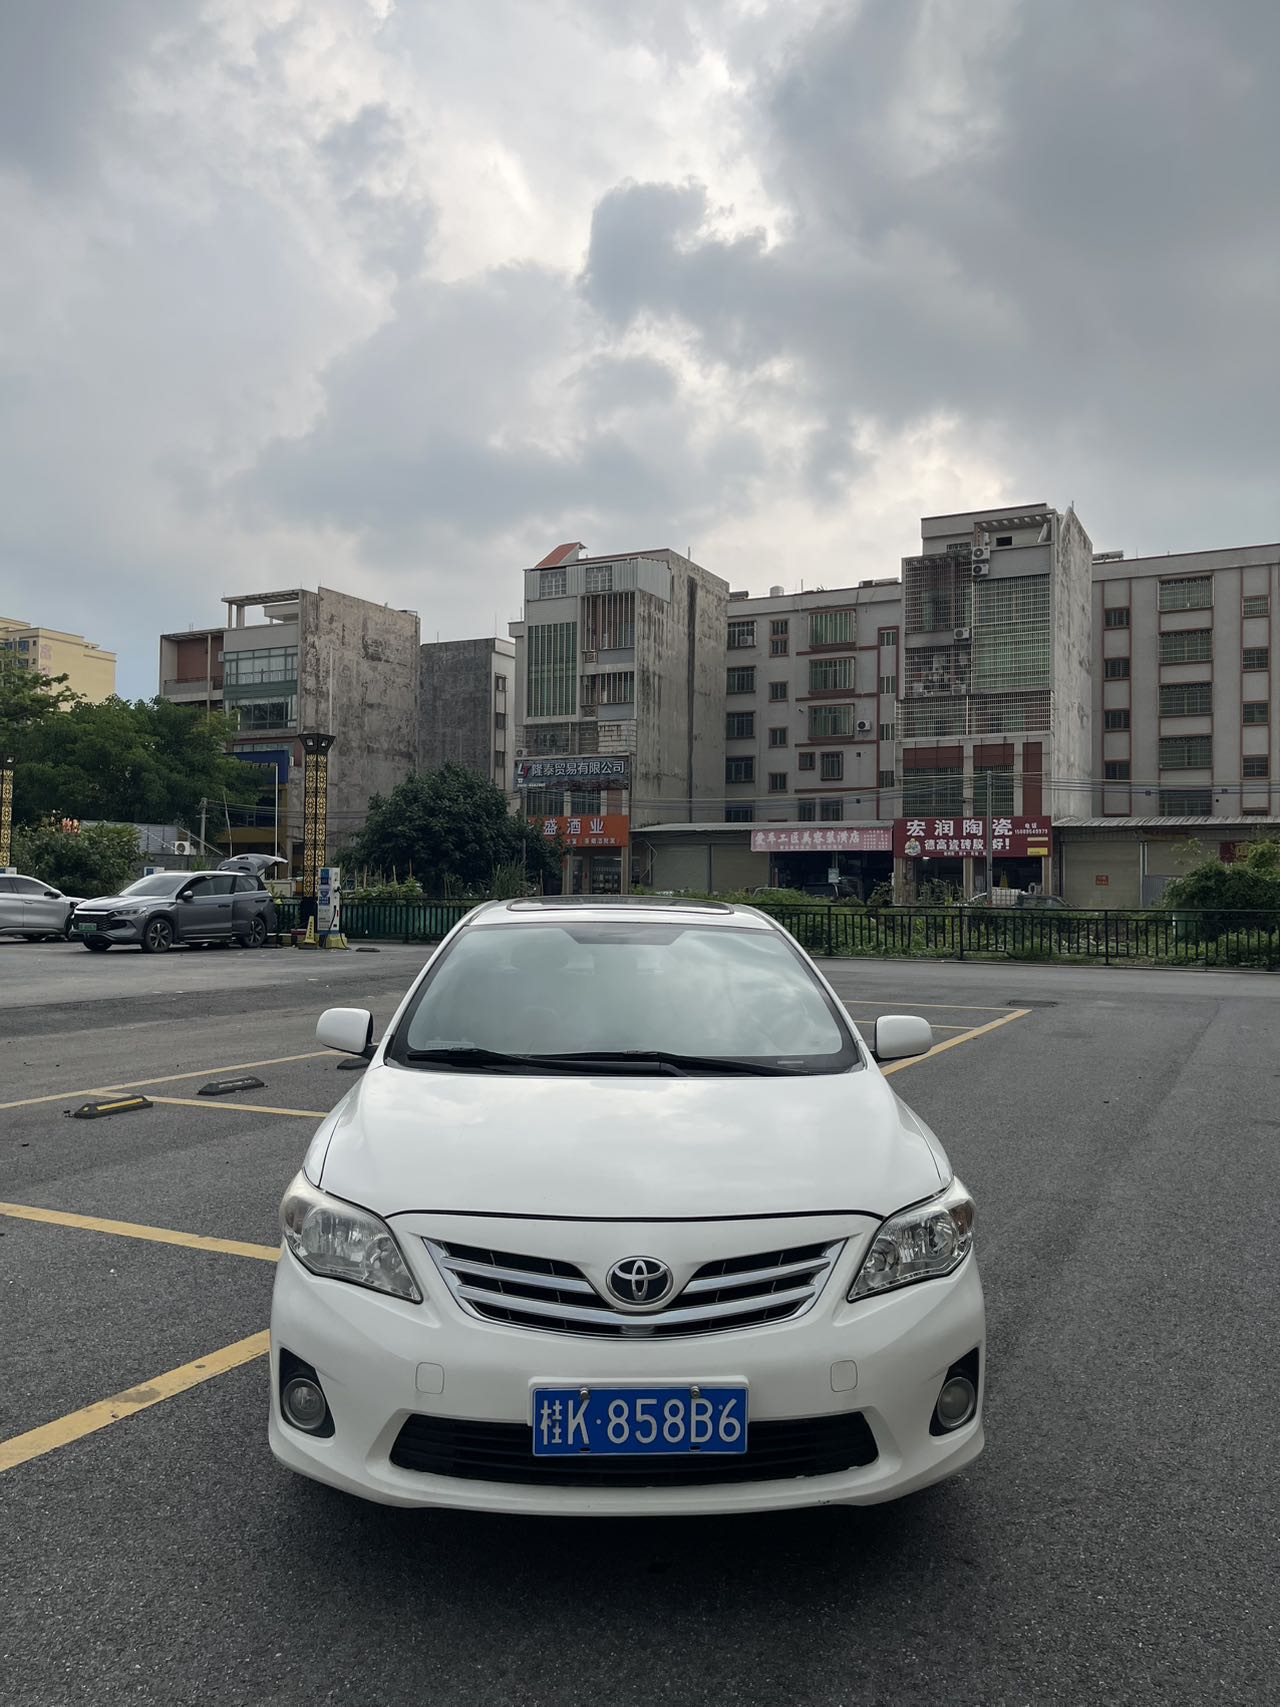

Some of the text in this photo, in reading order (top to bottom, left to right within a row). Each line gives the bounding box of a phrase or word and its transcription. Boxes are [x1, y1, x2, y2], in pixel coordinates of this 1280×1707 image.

[532, 760, 625, 777] 隆泰贸易有限公司
[528, 817, 604, 836] 盛酒业
[906, 819, 1013, 836] 宏润陶瓷
[540, 1398, 741, 1446] 桂K·858B6
